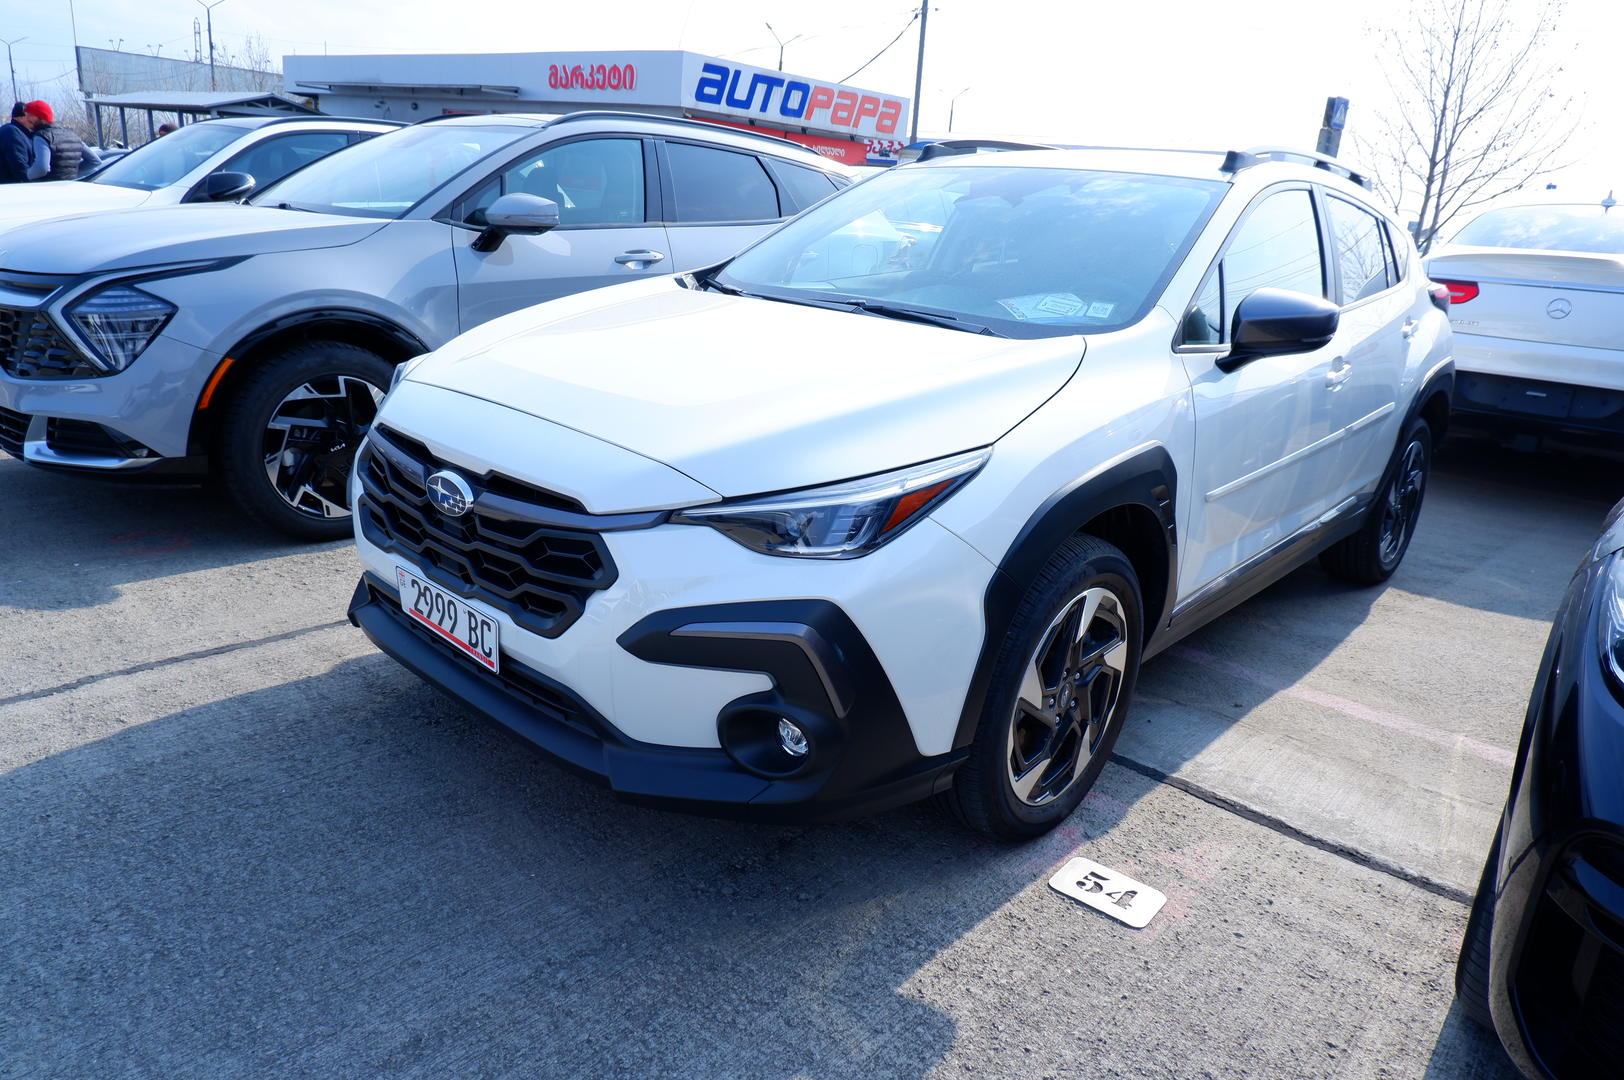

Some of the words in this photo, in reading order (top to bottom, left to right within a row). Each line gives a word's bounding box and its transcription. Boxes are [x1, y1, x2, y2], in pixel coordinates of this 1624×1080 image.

[548, 63, 635, 90] მარკეტი
[411, 578, 458, 634] 2999
[467, 609, 493, 659] BC
[1075, 871, 1138, 910] 54
